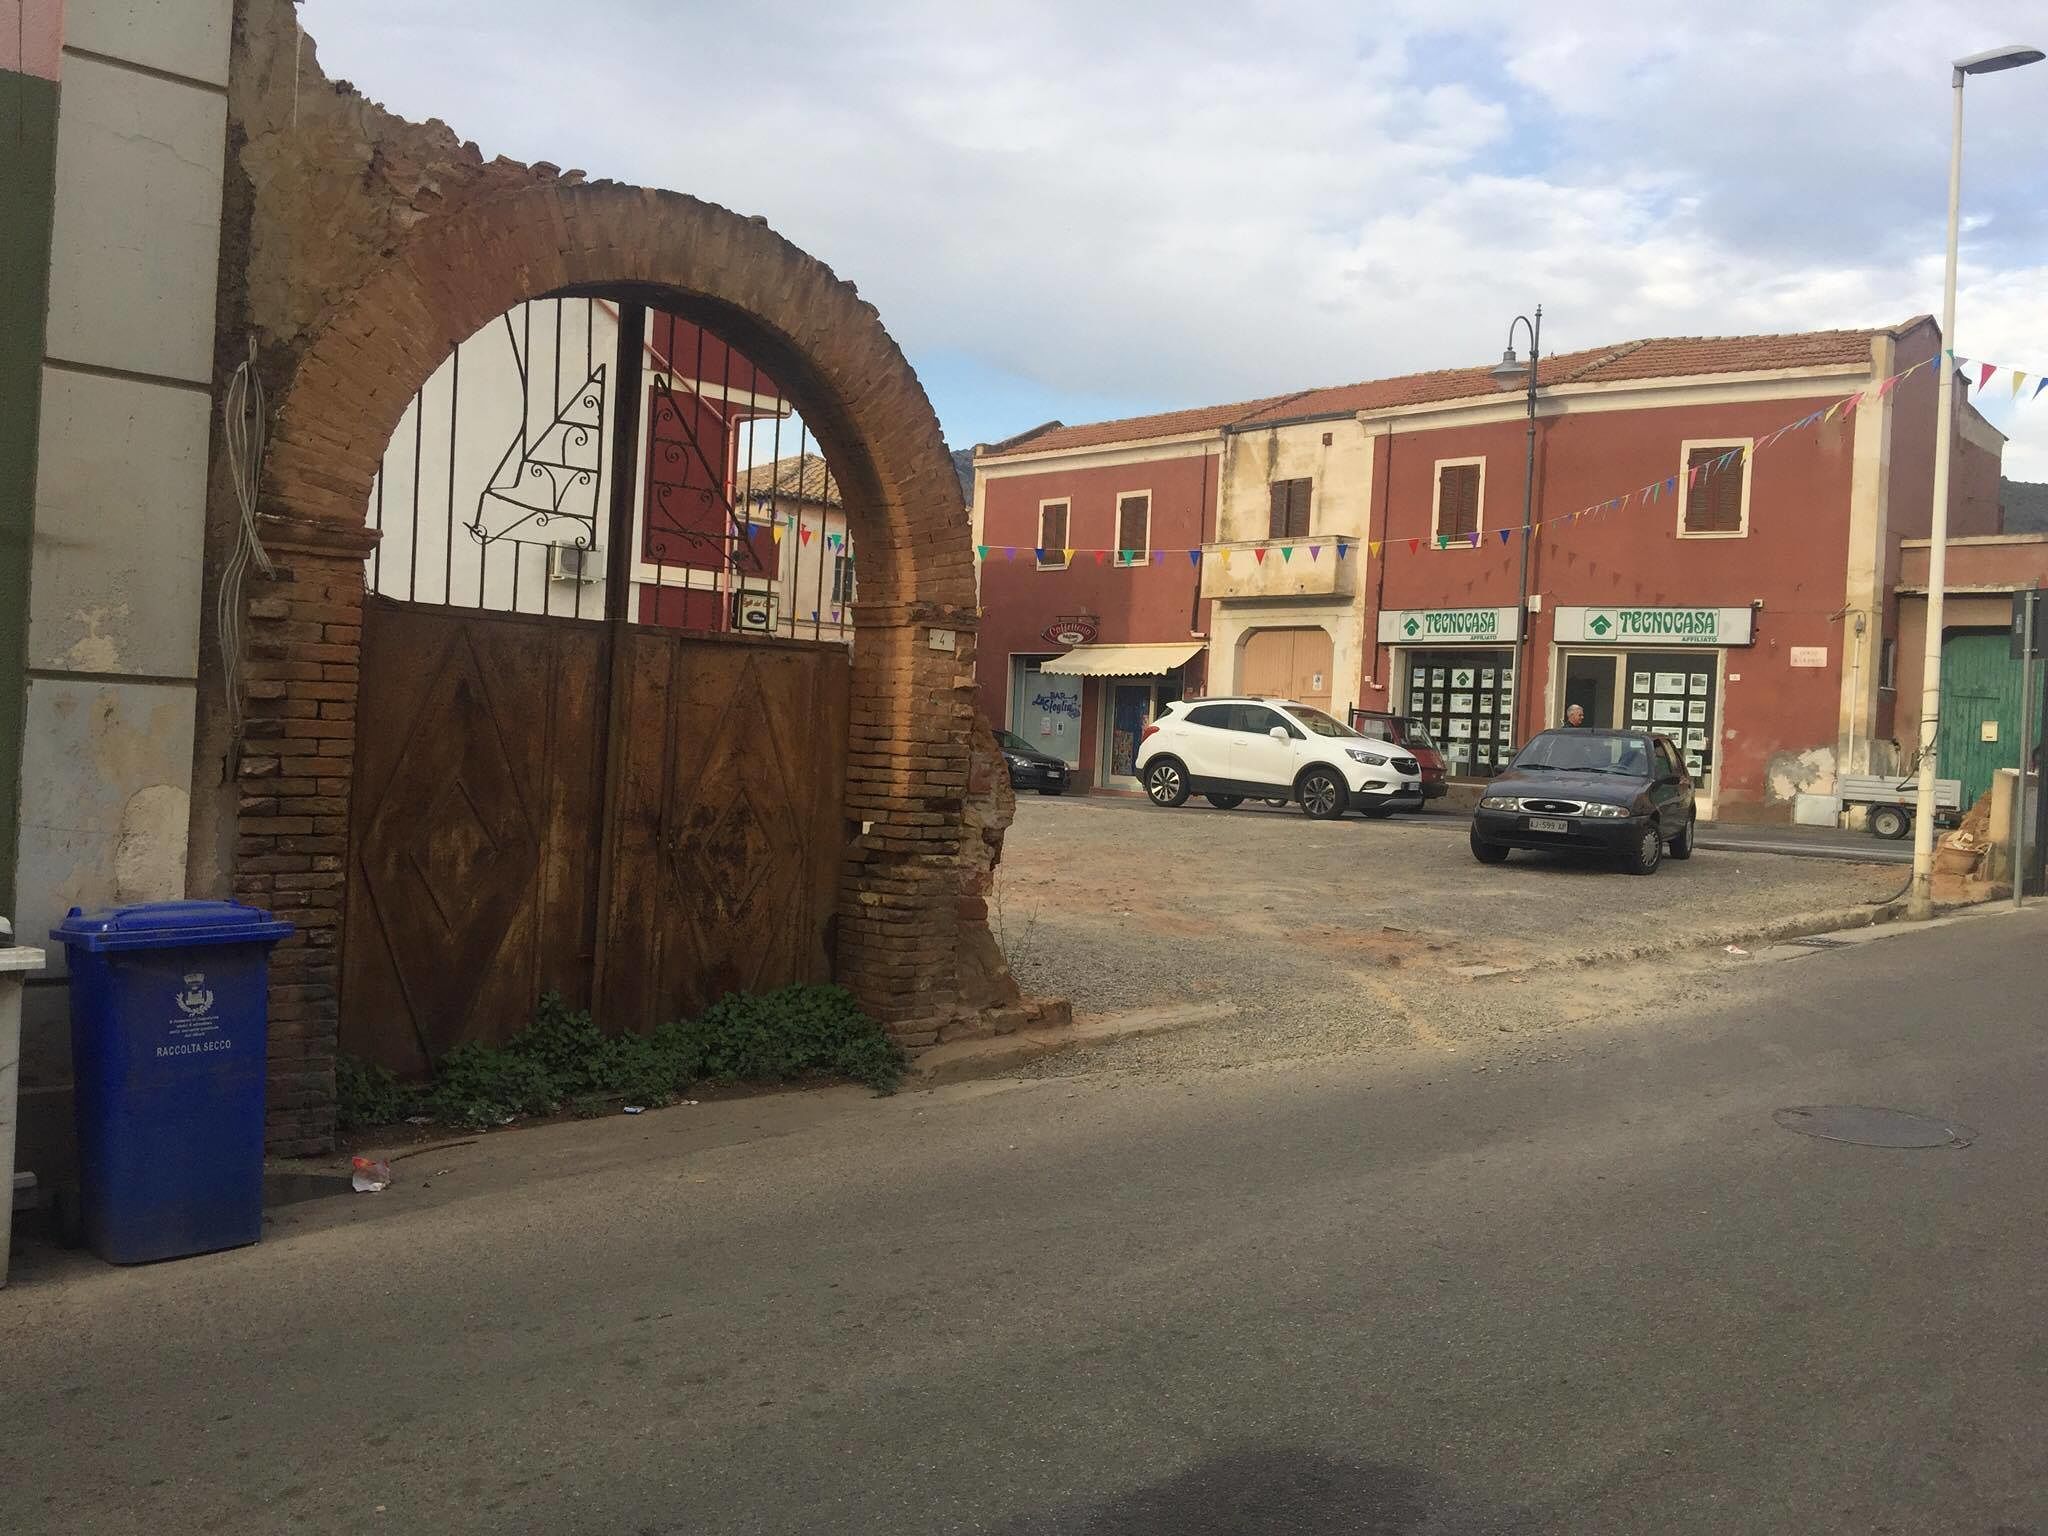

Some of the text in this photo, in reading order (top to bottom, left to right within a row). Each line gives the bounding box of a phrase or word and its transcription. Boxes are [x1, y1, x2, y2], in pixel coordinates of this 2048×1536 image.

[1425, 611, 1496, 634] TECNOCASA
[1619, 611, 1715, 635] TECNOCASA
[939, 632, 945, 645] 4
[1049, 691, 1066, 700] BAR
[156, 1039, 231, 1057] RACCOLTA SECCO
